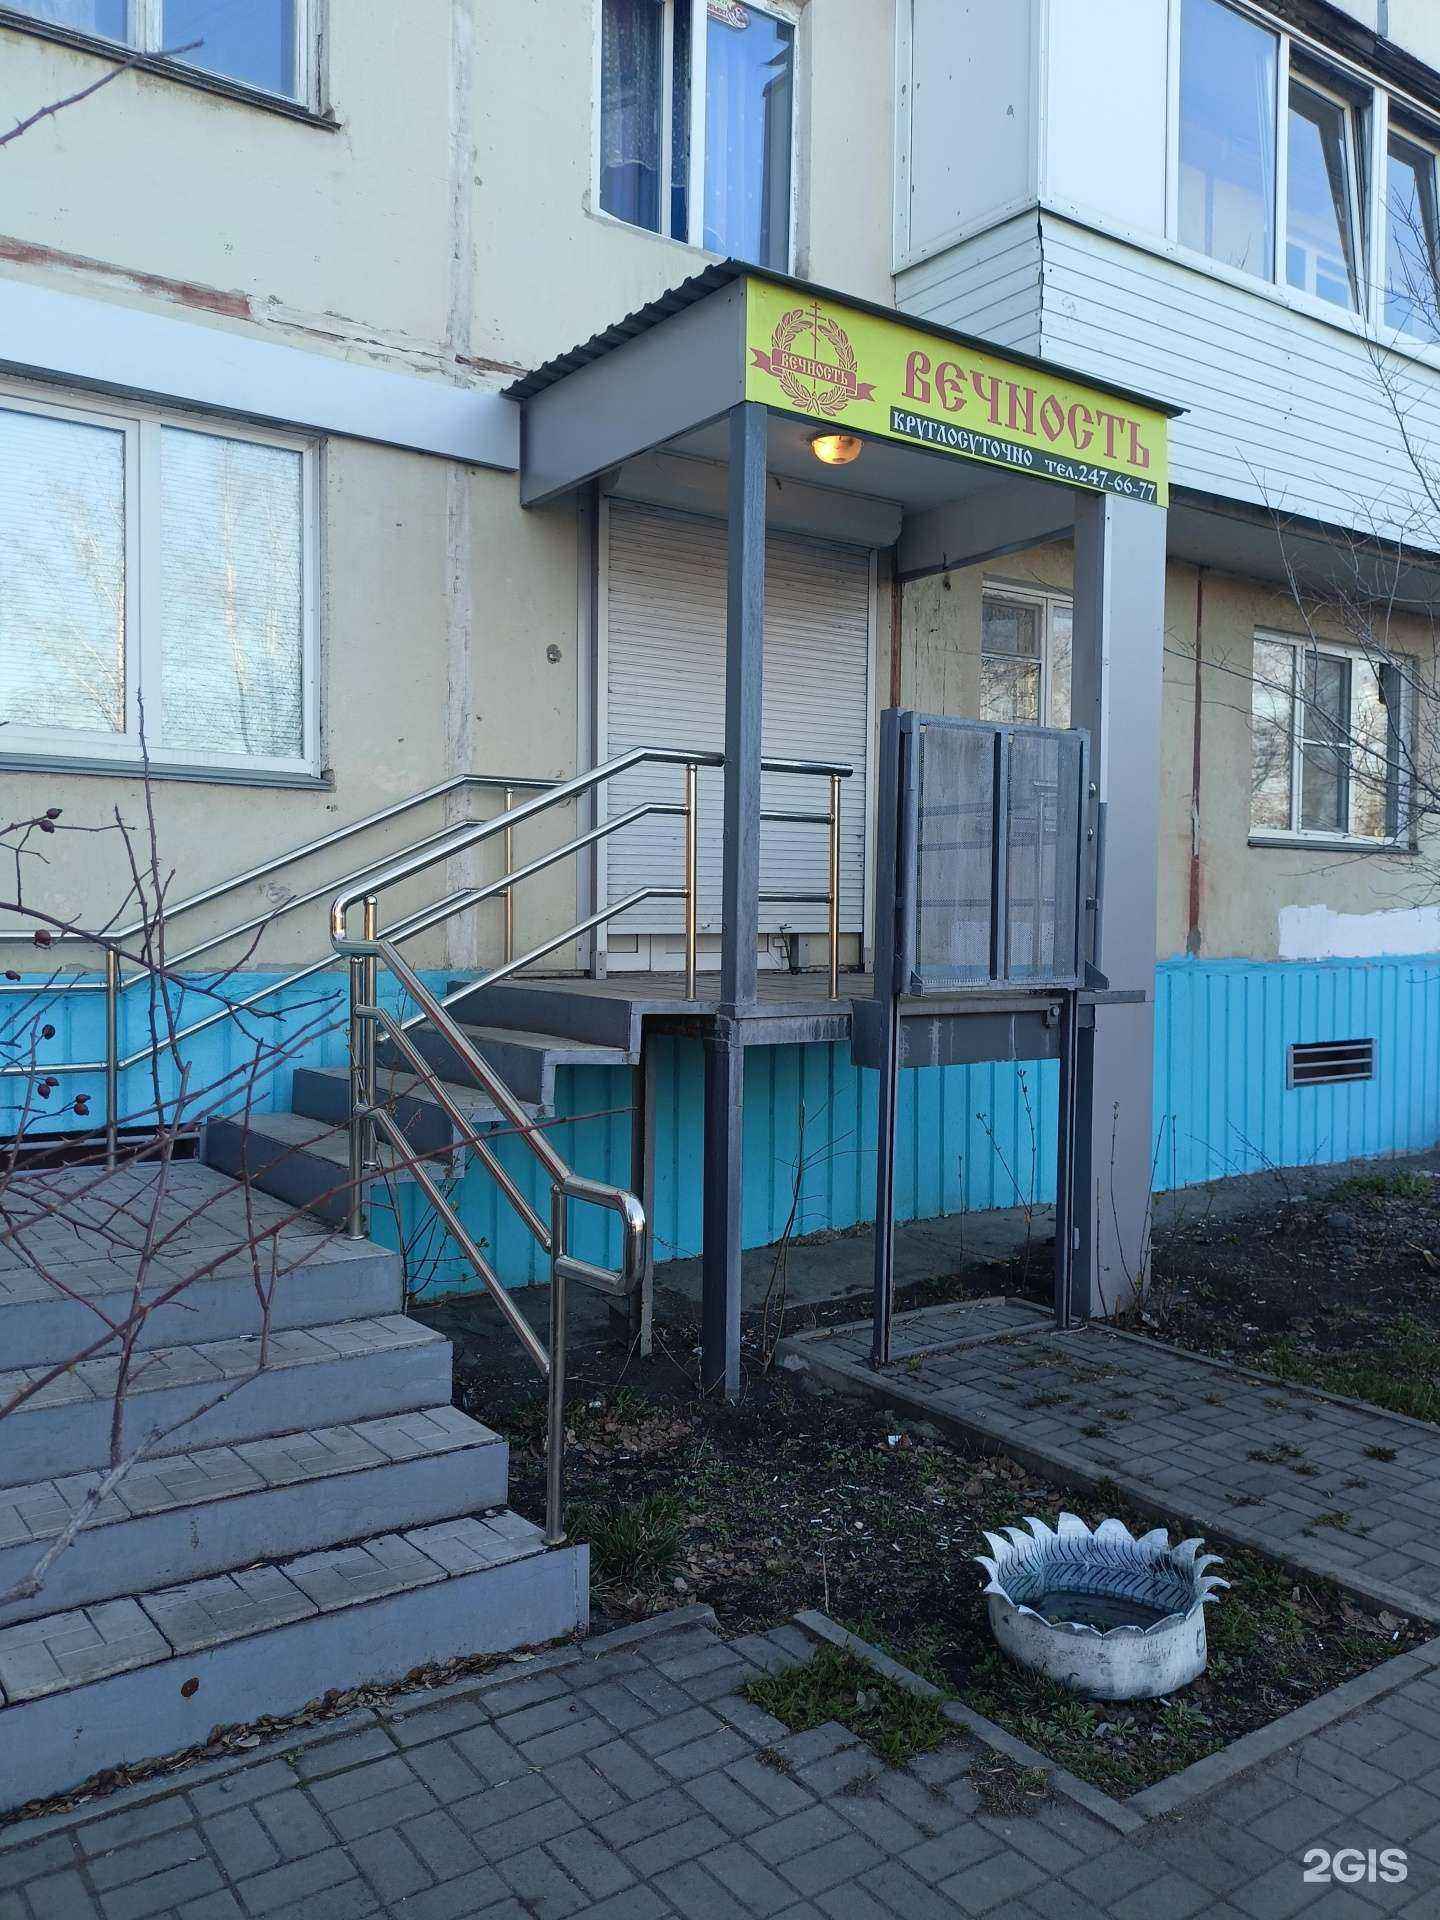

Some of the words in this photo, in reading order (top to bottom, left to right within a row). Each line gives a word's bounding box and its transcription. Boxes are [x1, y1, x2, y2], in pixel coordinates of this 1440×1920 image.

[781, 352, 848, 386] ВЕЧНОСТЬ
[901, 350, 1150, 469] ВЕЧНОСТЬ
[893, 410, 1033, 467] КРУГЛОСУТОЧНО
